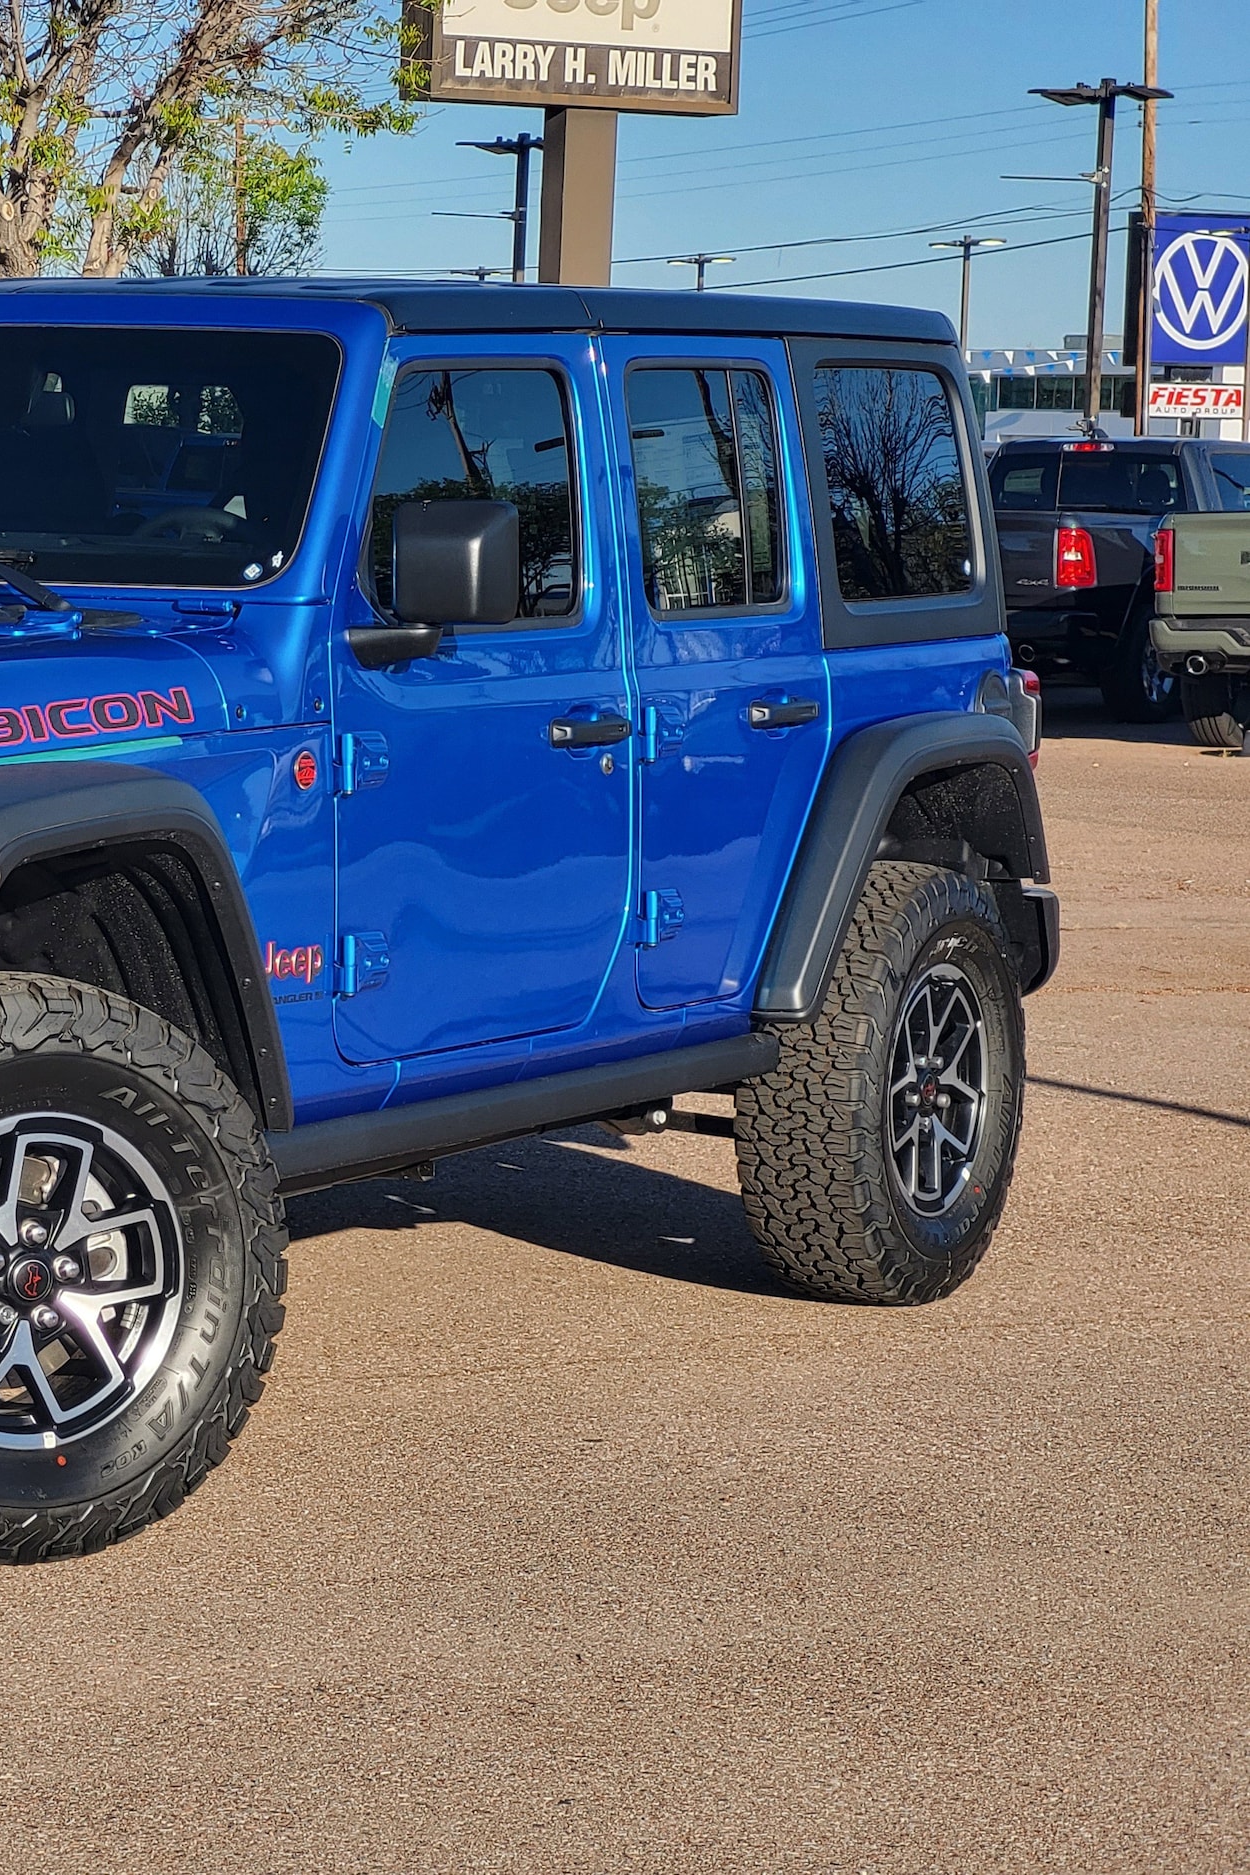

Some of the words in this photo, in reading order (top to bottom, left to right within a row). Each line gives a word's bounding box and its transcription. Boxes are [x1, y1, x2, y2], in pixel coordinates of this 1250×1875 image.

[454, 39, 556, 81] LARRY
[564, 46, 596, 84] H.
[608, 49, 718, 92] MILLER
[1155, 406, 1187, 414] AUTO
[265, 940, 323, 985] Jeep
[273, 992, 313, 1005] ANGLER
